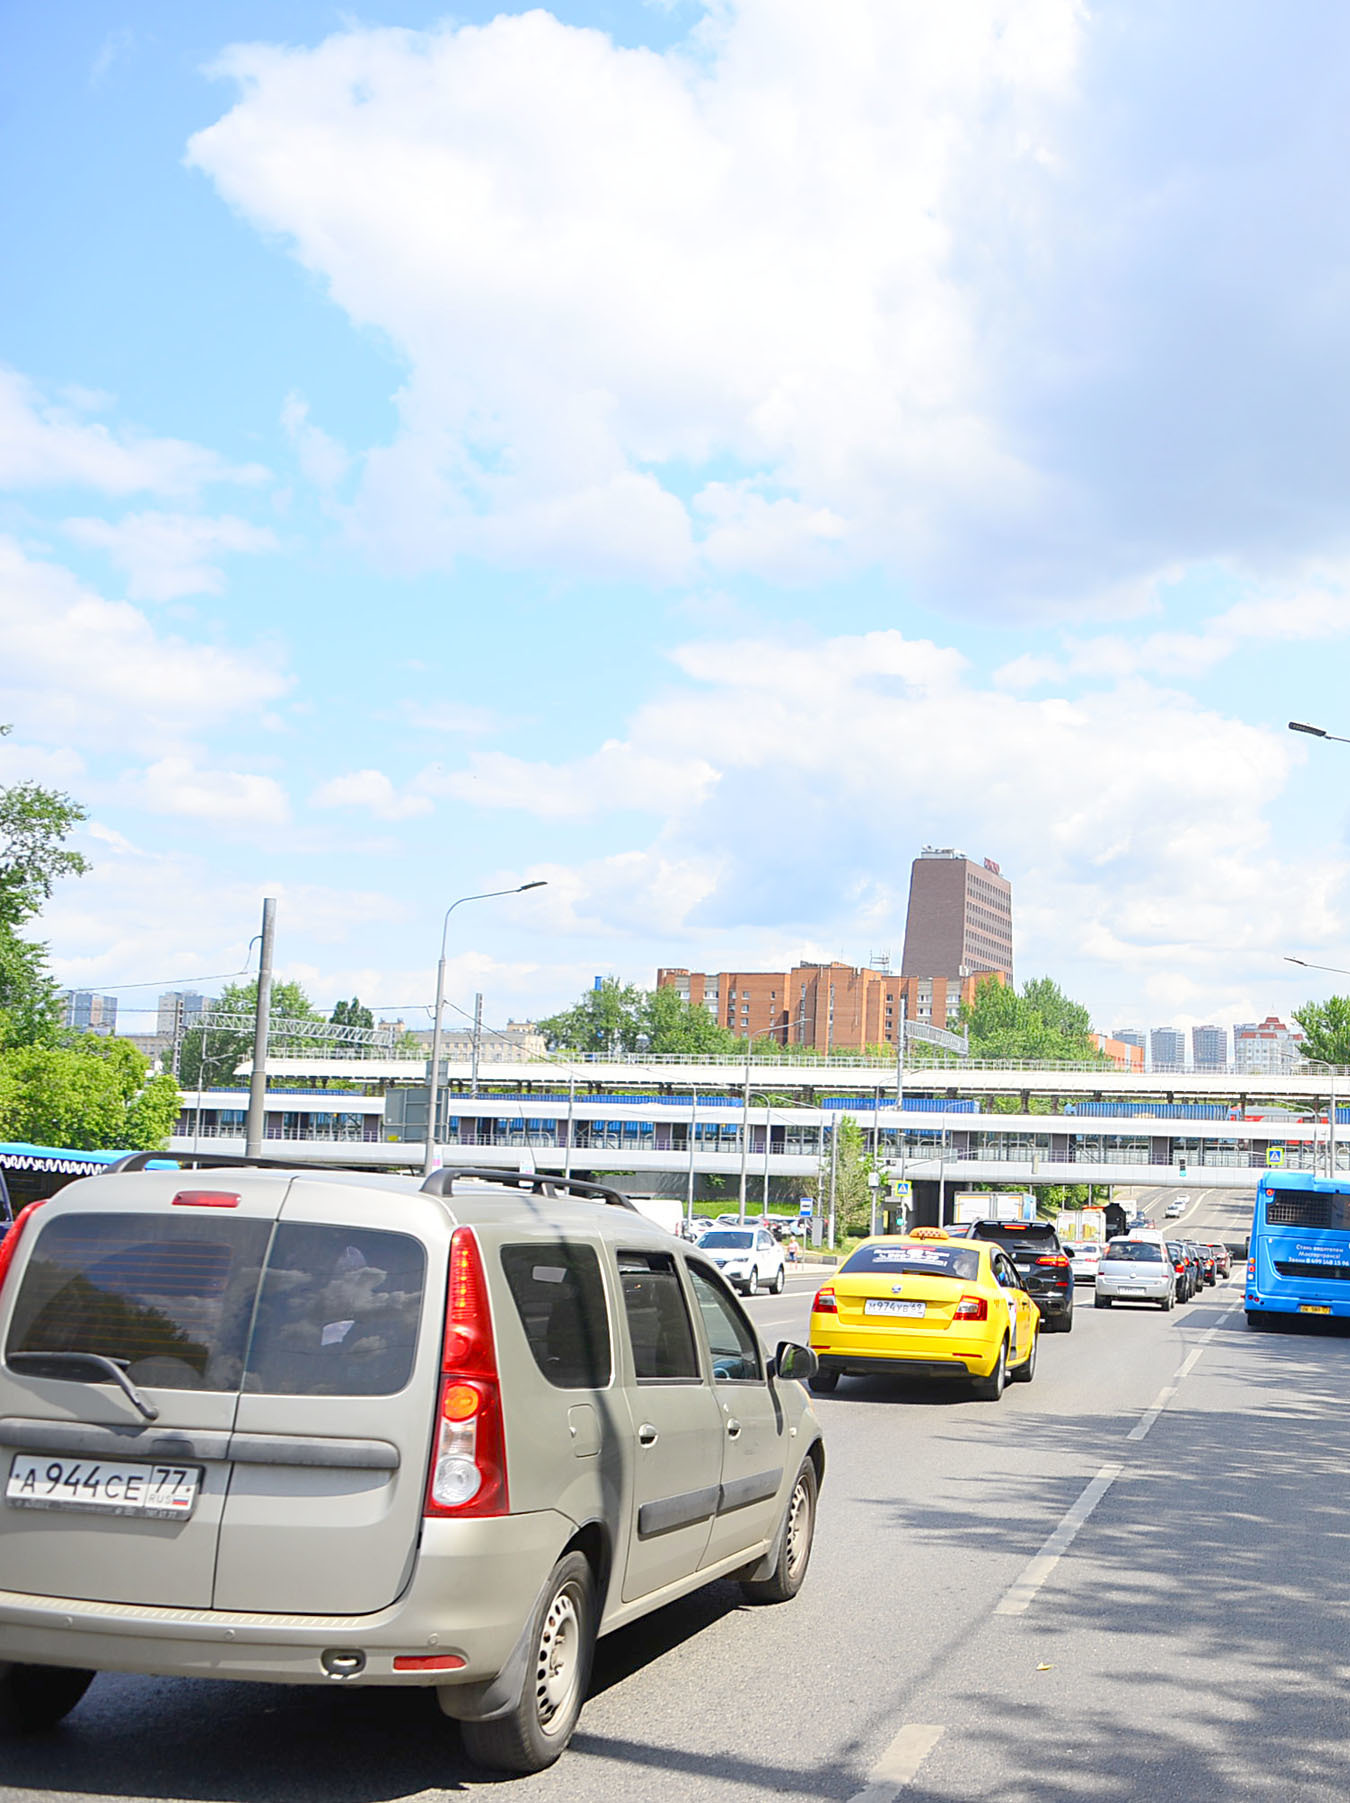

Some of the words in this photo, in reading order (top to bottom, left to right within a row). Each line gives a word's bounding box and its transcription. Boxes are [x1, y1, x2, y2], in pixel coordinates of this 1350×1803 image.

[20, 1462, 144, 1501] А944СЕ
[155, 1469, 187, 1495] 77
[148, 1494, 173, 1504] RUS
